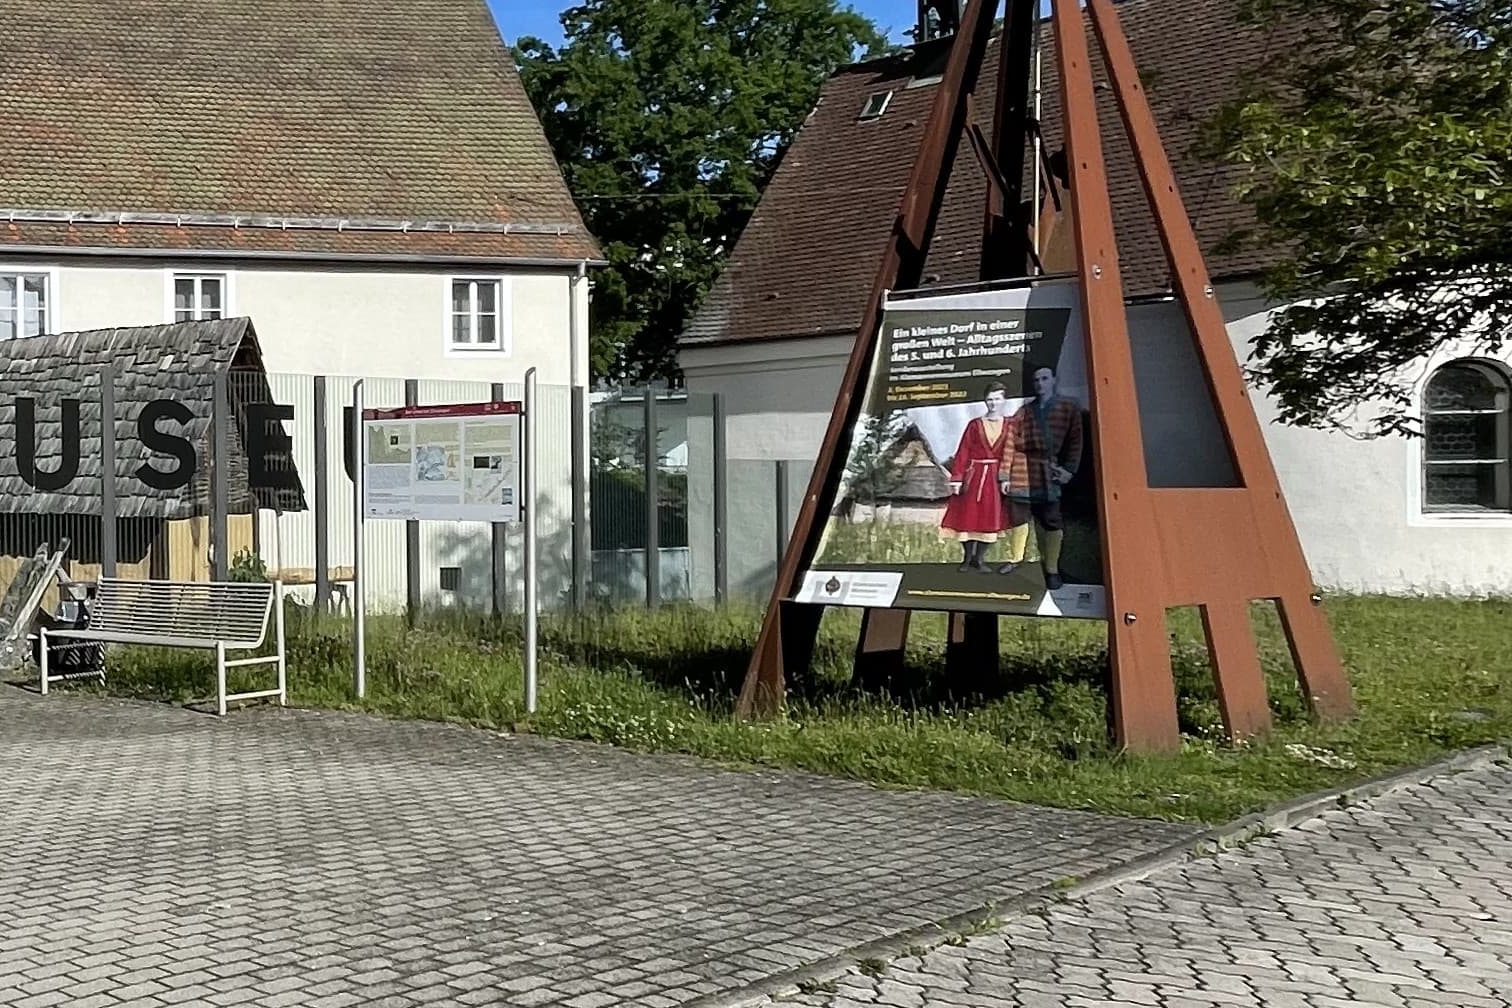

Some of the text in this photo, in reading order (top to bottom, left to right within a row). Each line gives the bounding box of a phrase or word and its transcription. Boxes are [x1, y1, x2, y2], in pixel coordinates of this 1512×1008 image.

[893, 320, 1020, 338] Ein kleines Dorf in einer
[891, 344, 1031, 362] des 5. und 6. Jahrhunderts
[892, 339, 930, 352] großen
[931, 336, 956, 347] Welt
